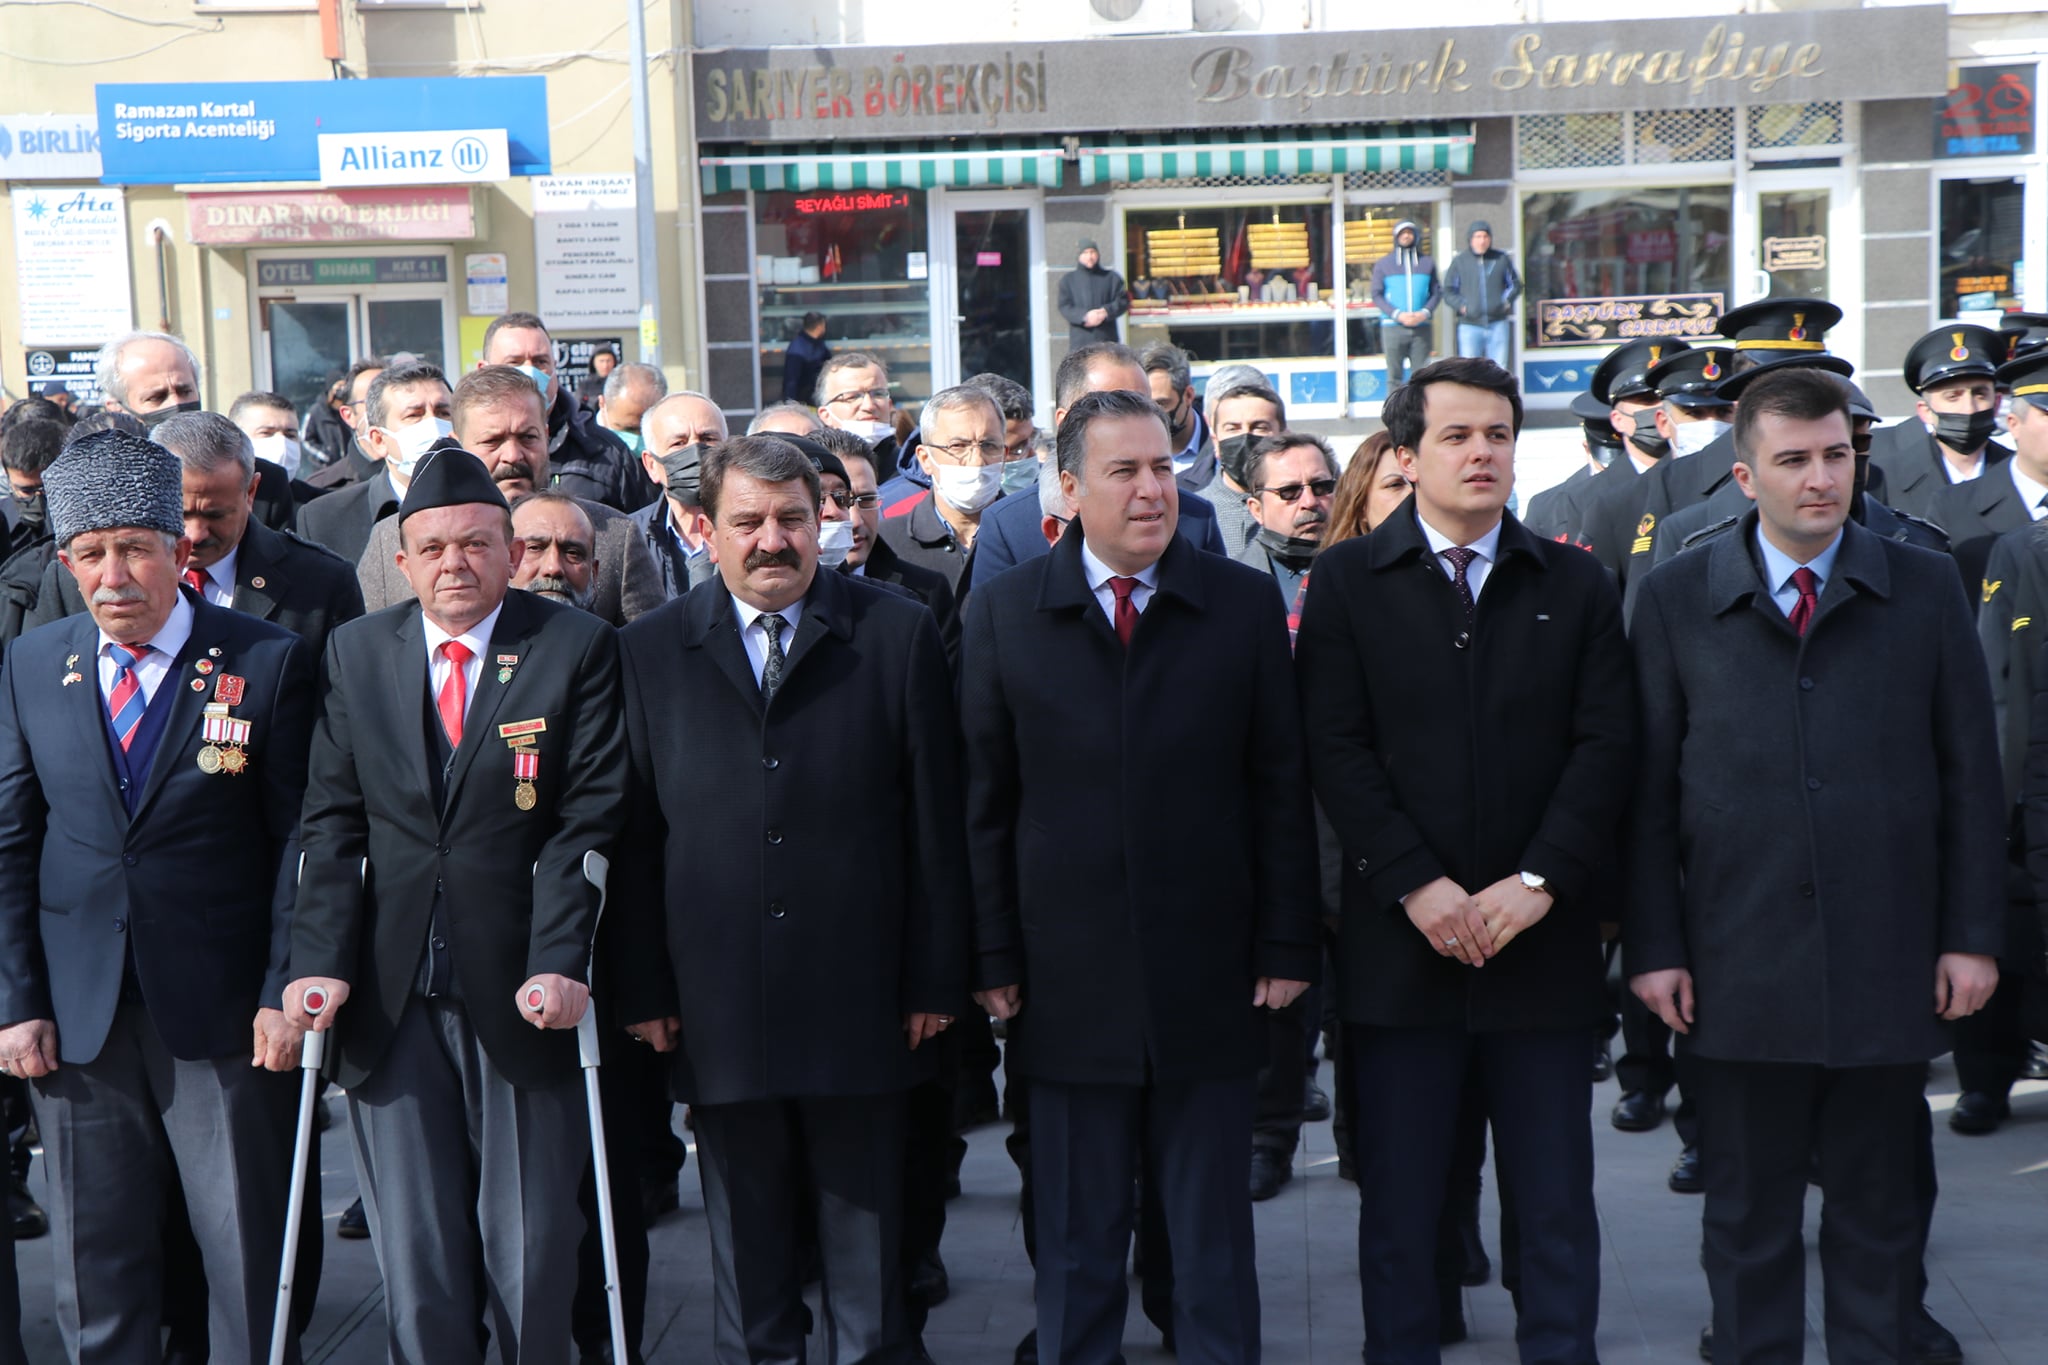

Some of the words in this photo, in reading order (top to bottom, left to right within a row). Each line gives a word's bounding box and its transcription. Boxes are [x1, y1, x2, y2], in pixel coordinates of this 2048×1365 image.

[1190, 37, 1473, 114] Baştürk
[1491, 23, 1825, 95] Sarrafiye
[706, 65, 854, 123] SARIYER
[863, 50, 1047, 127] BÖREKÇİSİ
[114, 103, 198, 120] Ramazan
[201, 100, 255, 118] Kartal
[116, 122, 182, 142] Sigorta
[185, 120, 275, 141] Acenteliği
[340, 145, 443, 171] Allianz
[57, 191, 116, 213] Ata
[857, 192, 893, 211] SİMİT
[261, 263, 312, 282] OTEL
